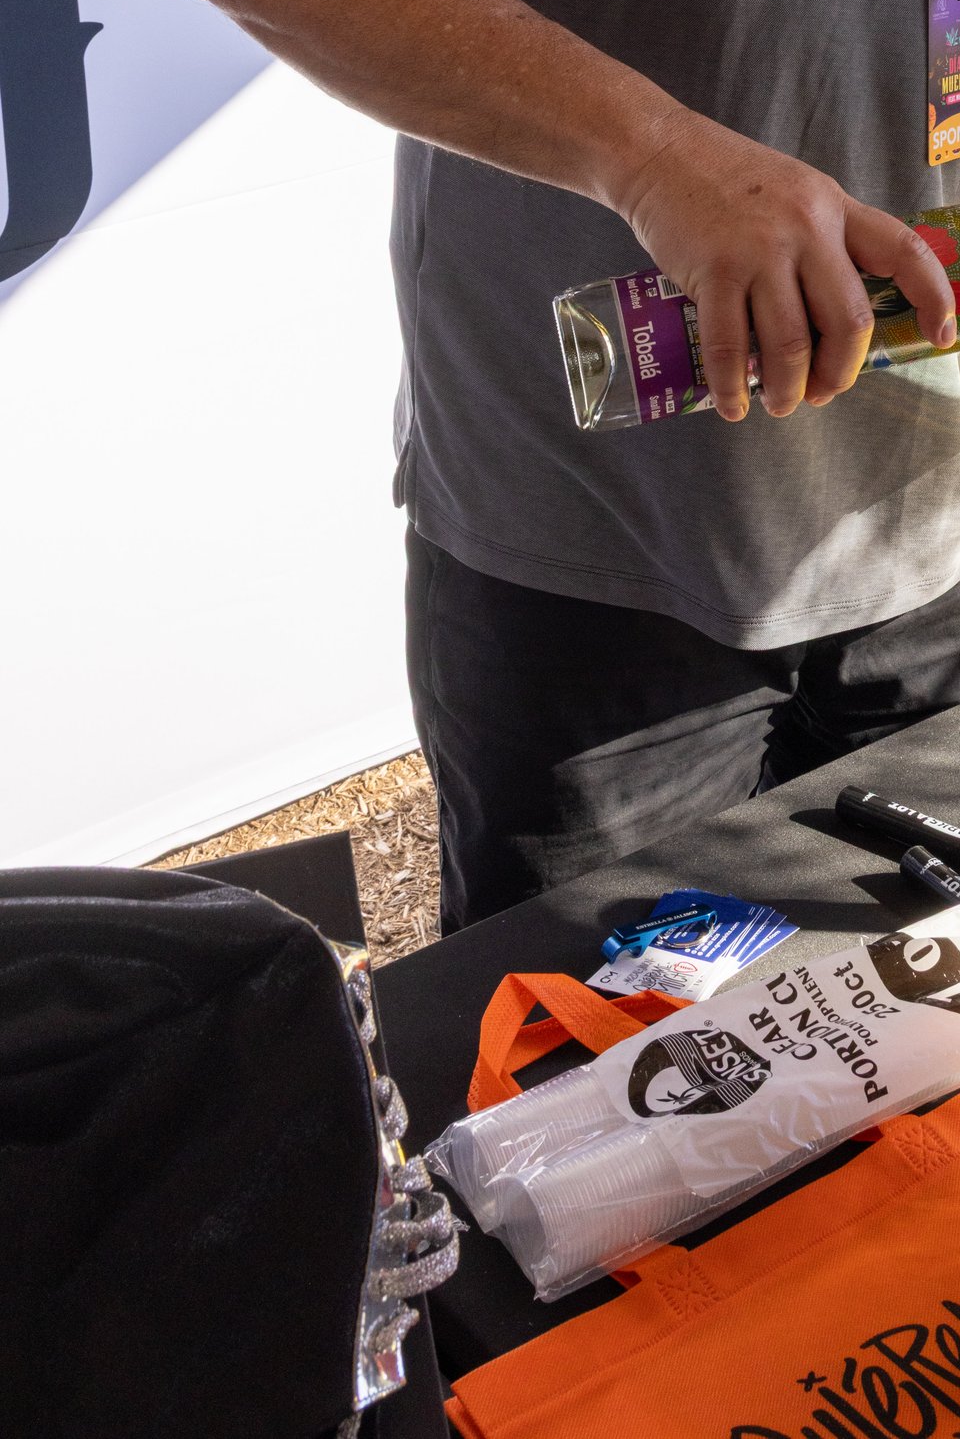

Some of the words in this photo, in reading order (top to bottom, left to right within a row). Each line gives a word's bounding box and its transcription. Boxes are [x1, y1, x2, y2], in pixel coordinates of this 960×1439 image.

[632, 321, 662, 380] Tobalá
[636, 918, 668, 930] ESTRELLA
[673, 910, 698, 922] JALISCO
[789, 1007, 889, 1104] PORTION
